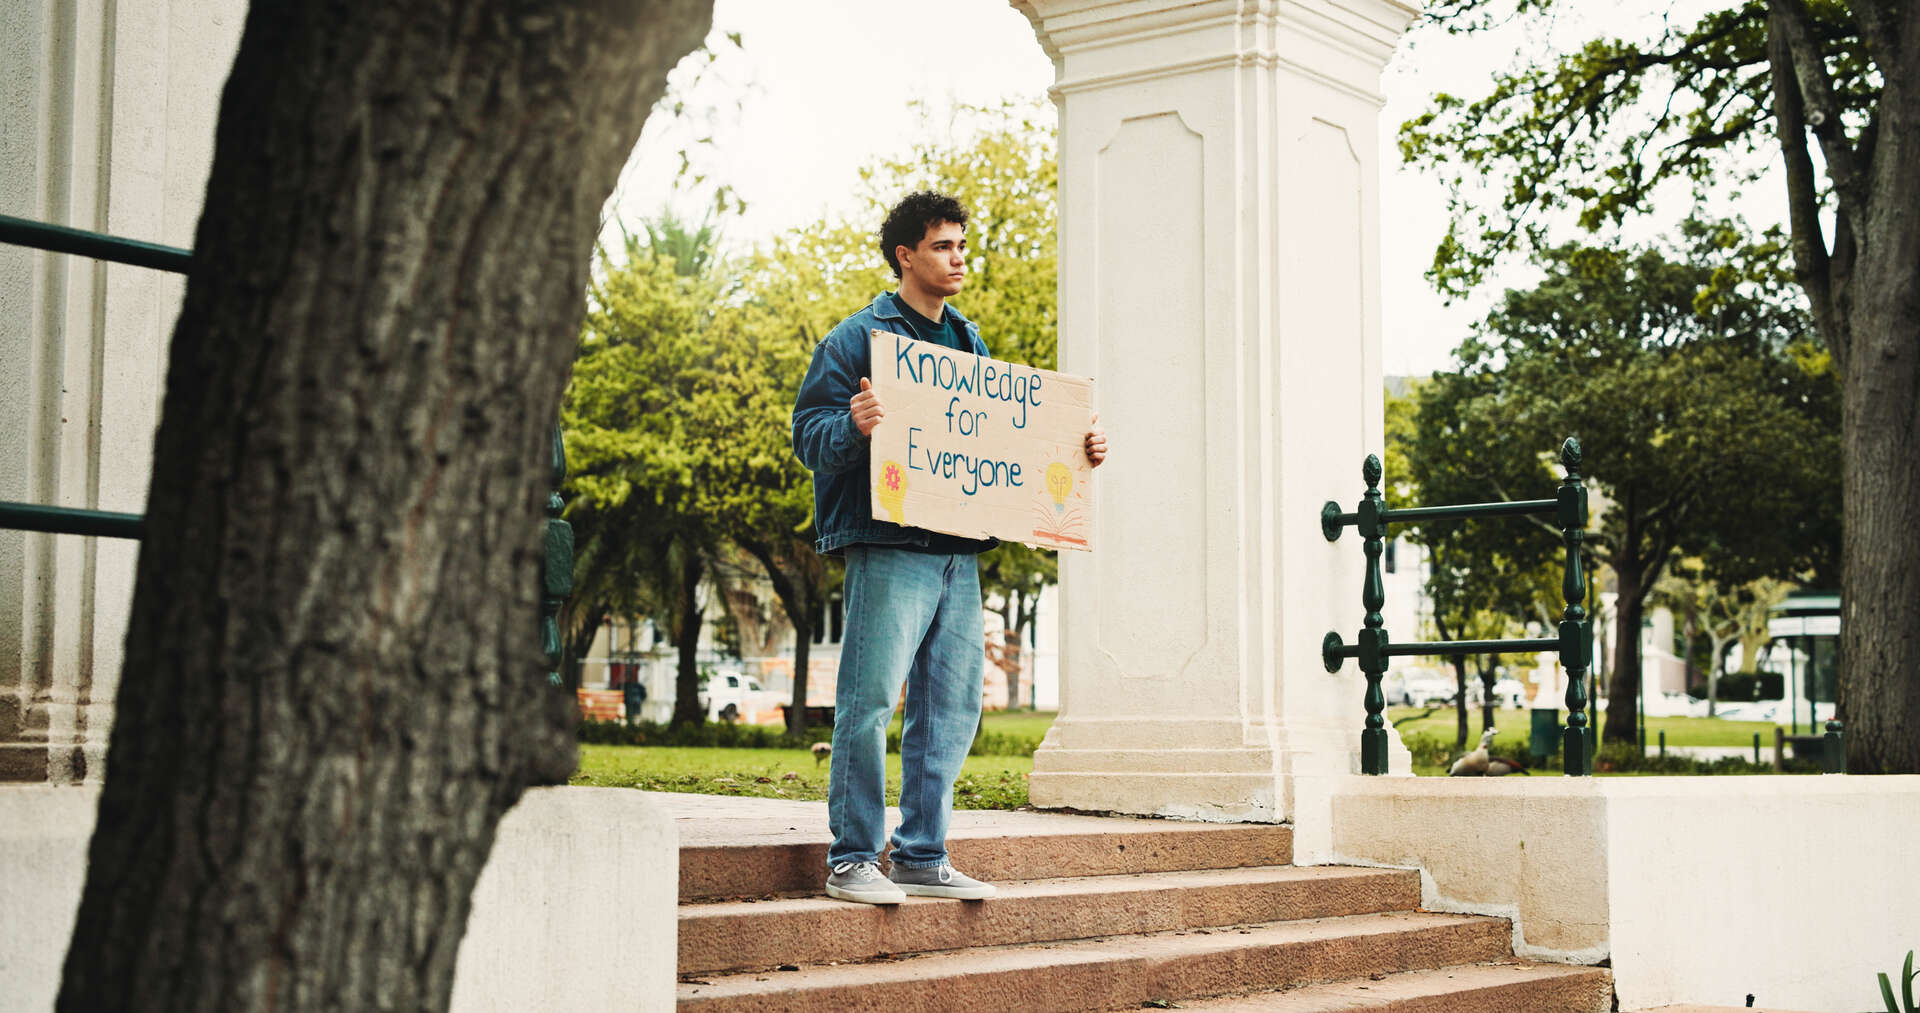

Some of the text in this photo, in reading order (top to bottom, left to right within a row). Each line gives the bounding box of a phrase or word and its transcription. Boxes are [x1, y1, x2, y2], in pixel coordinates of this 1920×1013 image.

[896, 337, 1042, 428] Knowledge
[945, 397, 987, 437] for
[909, 427, 1024, 496] Everyone
